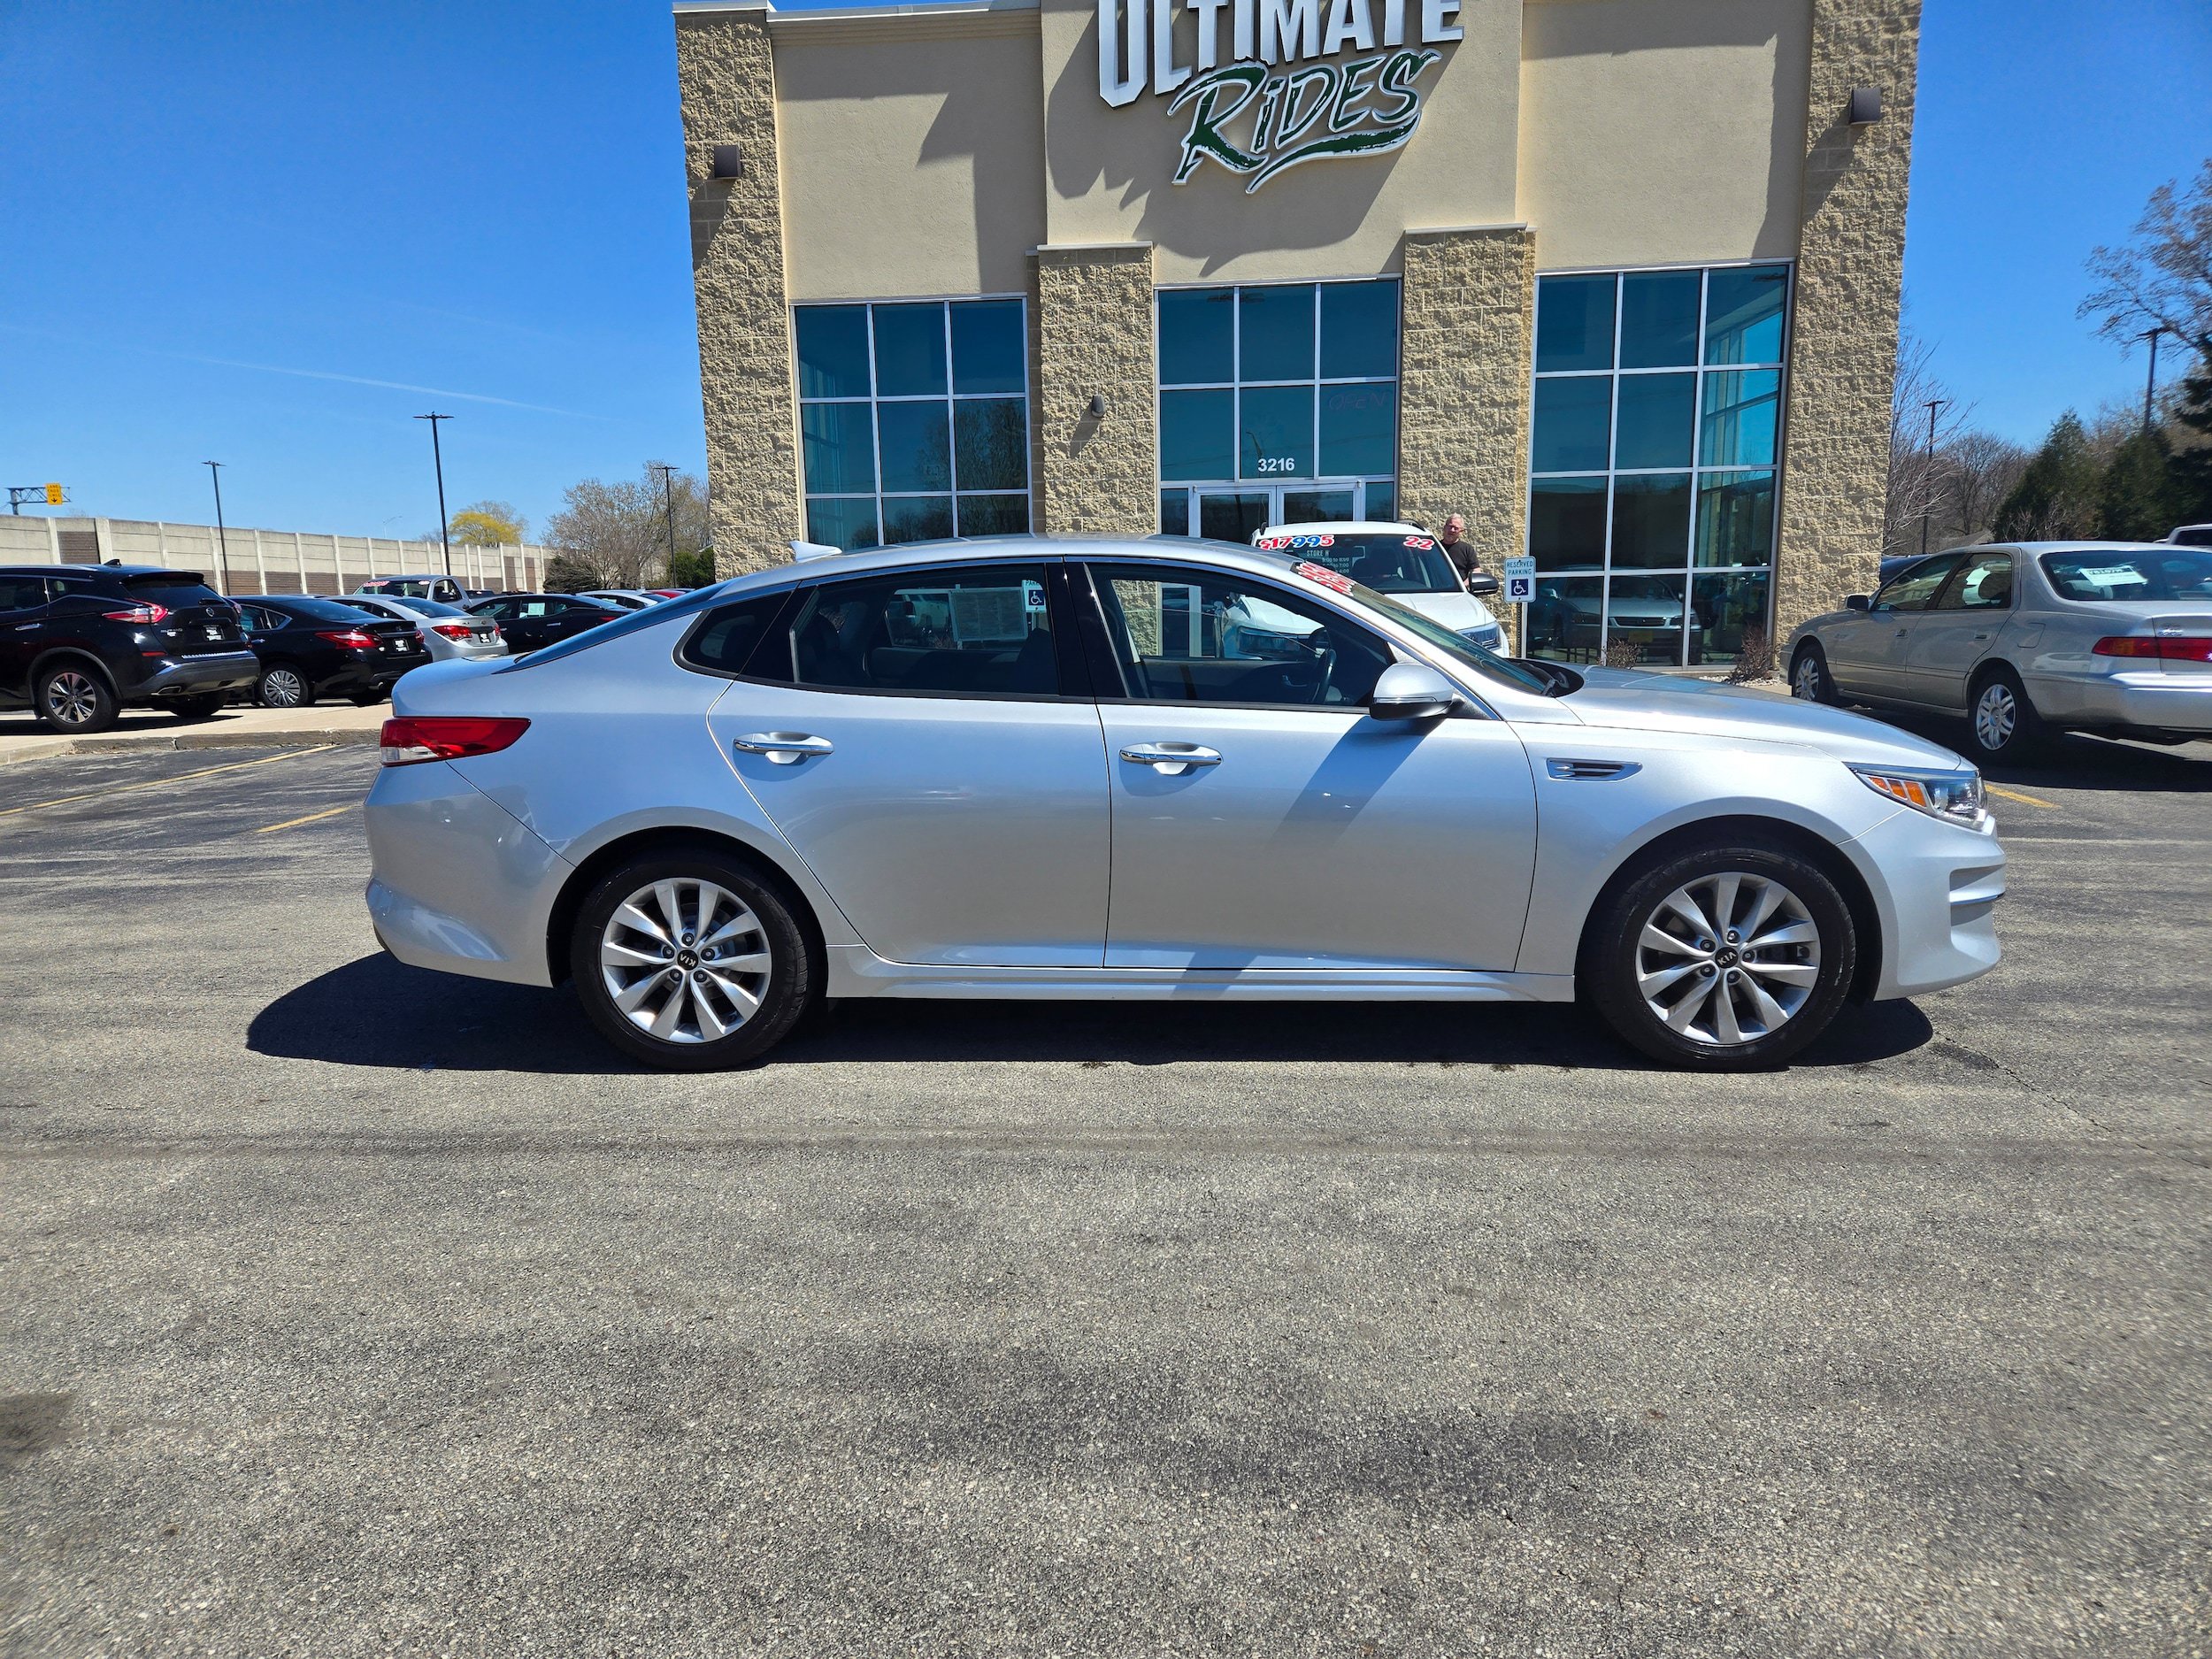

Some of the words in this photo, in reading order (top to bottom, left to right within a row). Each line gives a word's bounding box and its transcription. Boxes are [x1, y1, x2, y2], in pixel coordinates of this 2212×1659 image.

[1098, 0, 1464, 108] ULTIMATE
[1257, 457, 1295, 472] 3216
[1403, 535, 1435, 550] 22
[680, 954, 696, 967] KIA
[1717, 951, 1737, 965] KIA
